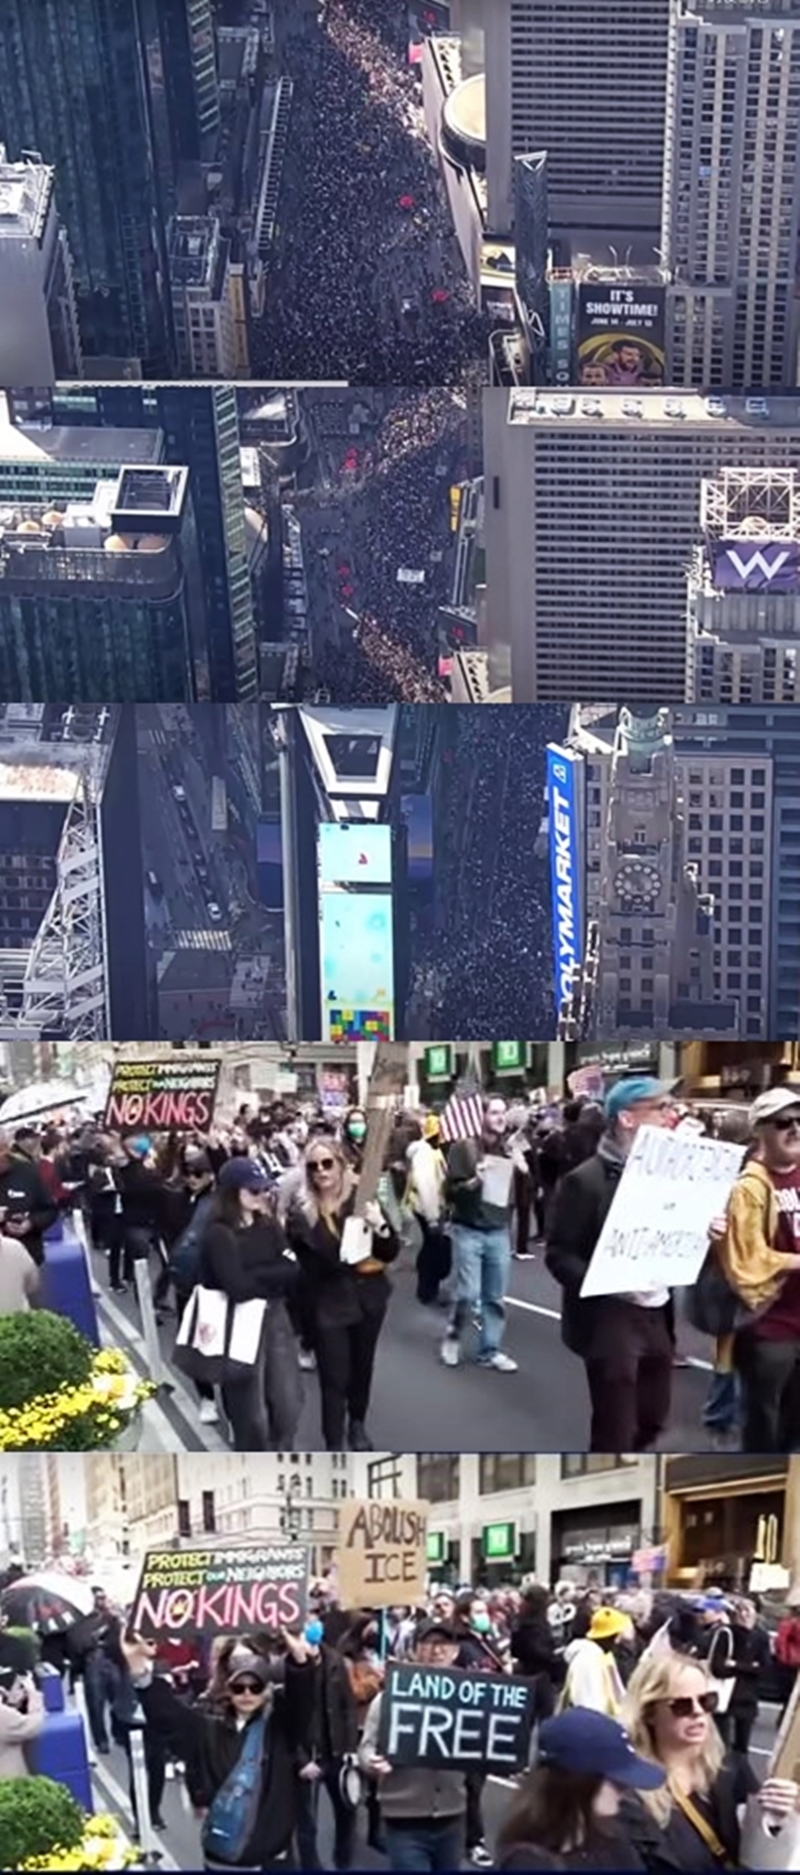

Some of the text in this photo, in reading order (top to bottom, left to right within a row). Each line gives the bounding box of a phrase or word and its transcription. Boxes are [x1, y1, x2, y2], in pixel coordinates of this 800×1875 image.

[586, 303, 658, 316] SHOWTIME!
[610, 290, 634, 302] IT'S
[725, 550, 791, 580] W
[106, 1091, 210, 1126] NO KINGS
[346, 1504, 426, 1548] ABOLISH
[148, 1552, 213, 1570] PROTECT
[364, 1551, 417, 1583] ICE
[142, 1570, 207, 1589] PROTECT
[133, 1583, 300, 1631] NO KINGS
[391, 1671, 528, 1709] LAND OF THE
[388, 1702, 522, 1762] FREE
